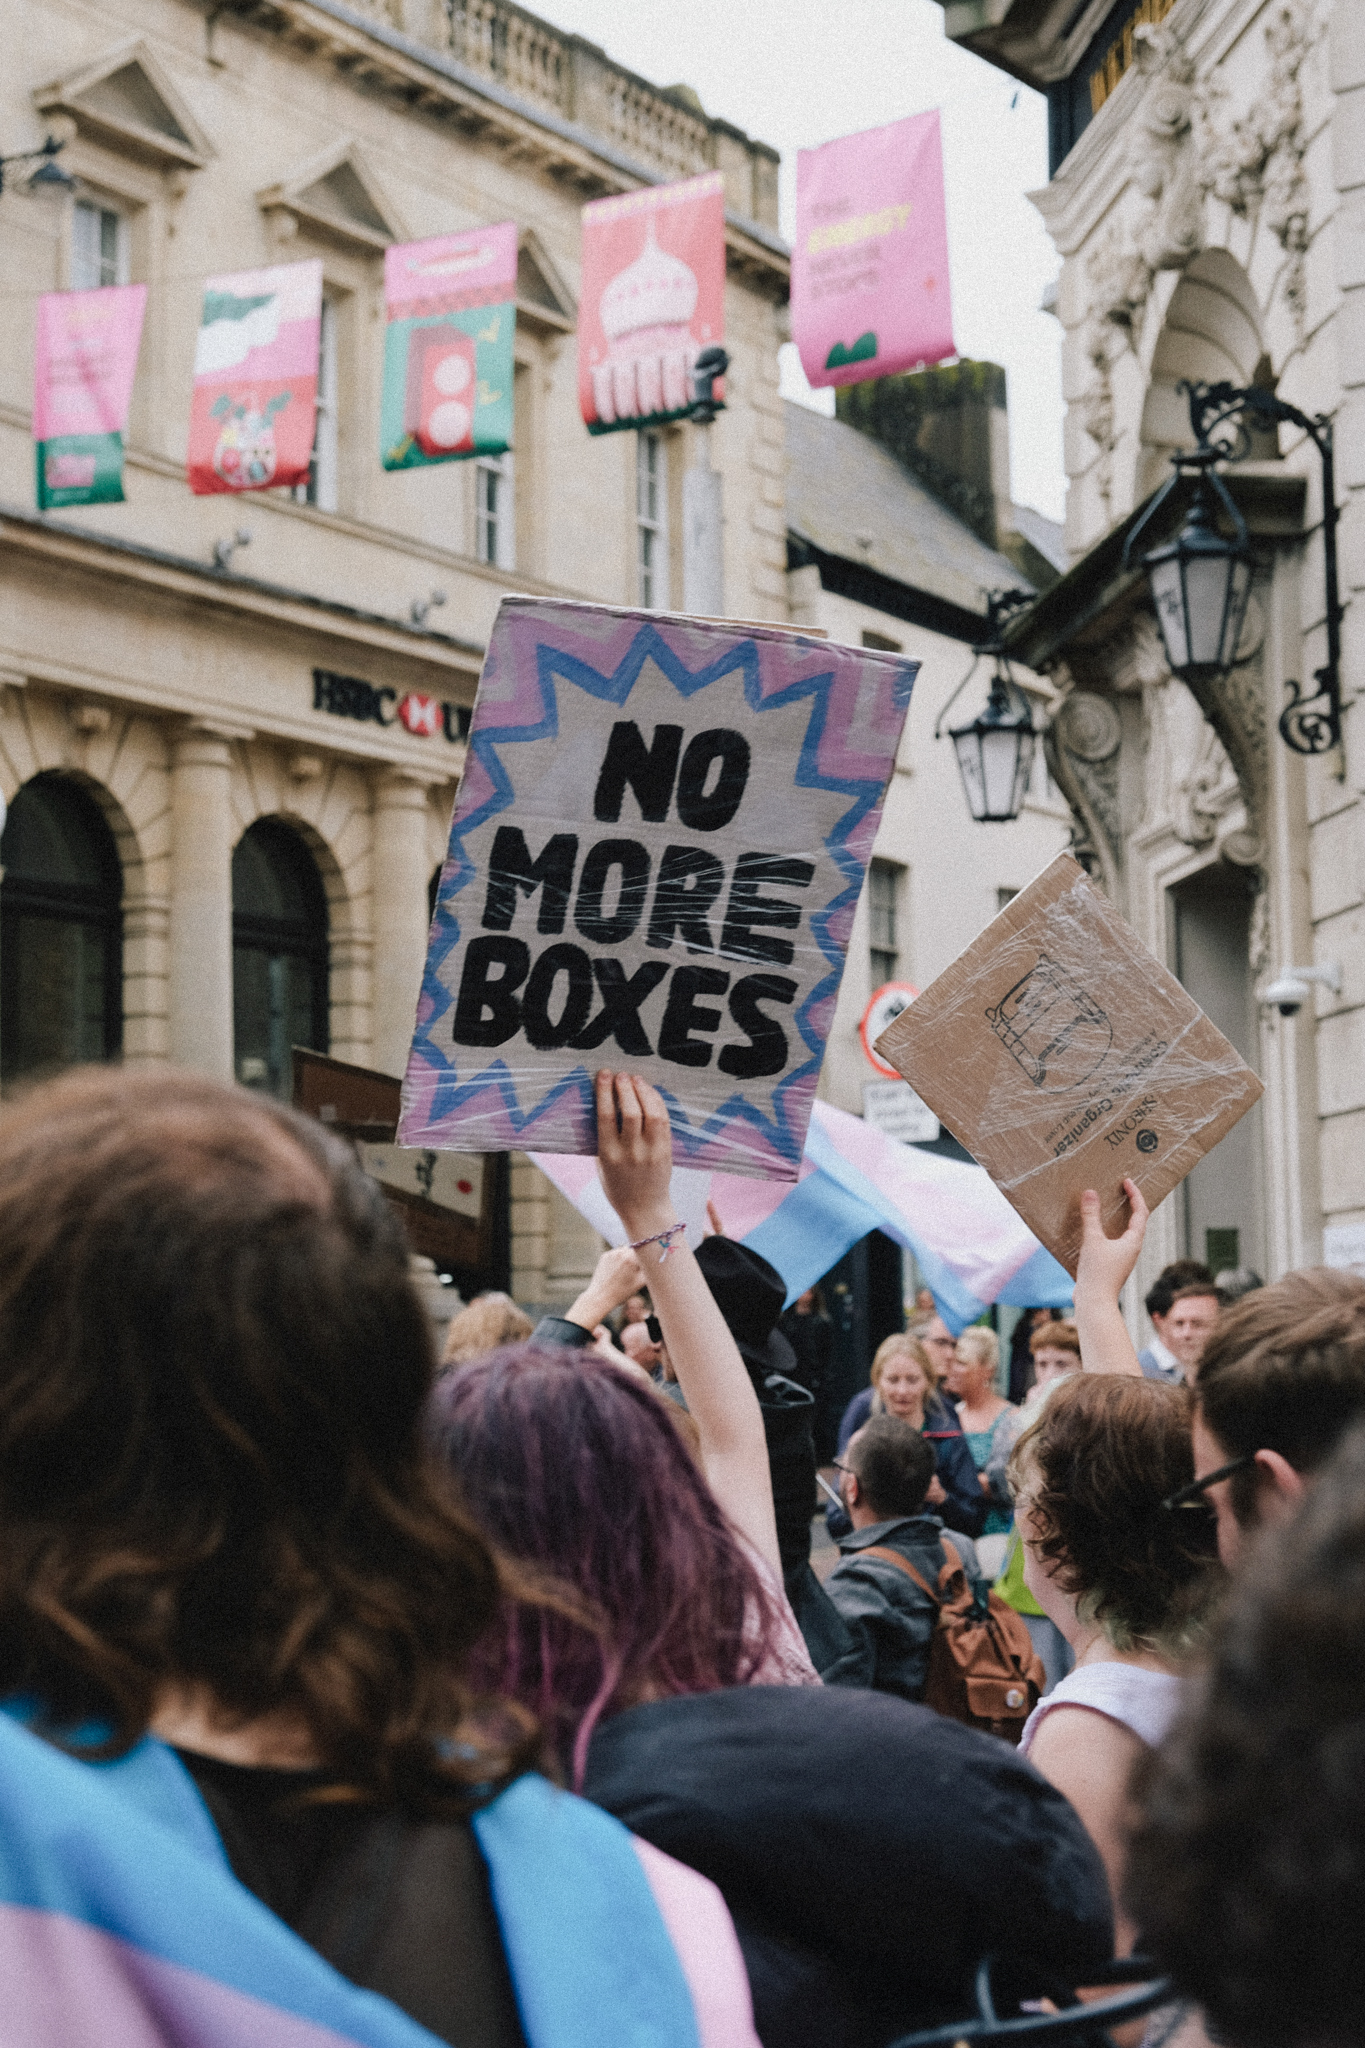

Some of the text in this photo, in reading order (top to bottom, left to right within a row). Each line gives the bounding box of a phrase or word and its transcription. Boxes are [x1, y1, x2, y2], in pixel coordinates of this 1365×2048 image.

[594, 720, 751, 832] NO
[481, 826, 816, 966] MORE
[452, 935, 799, 1080] BOXES
[1111, 1041, 1169, 1096] Cosmic
[1053, 1099, 1112, 1157] Organizer
[1103, 1095, 1157, 1150] SHEONLY
